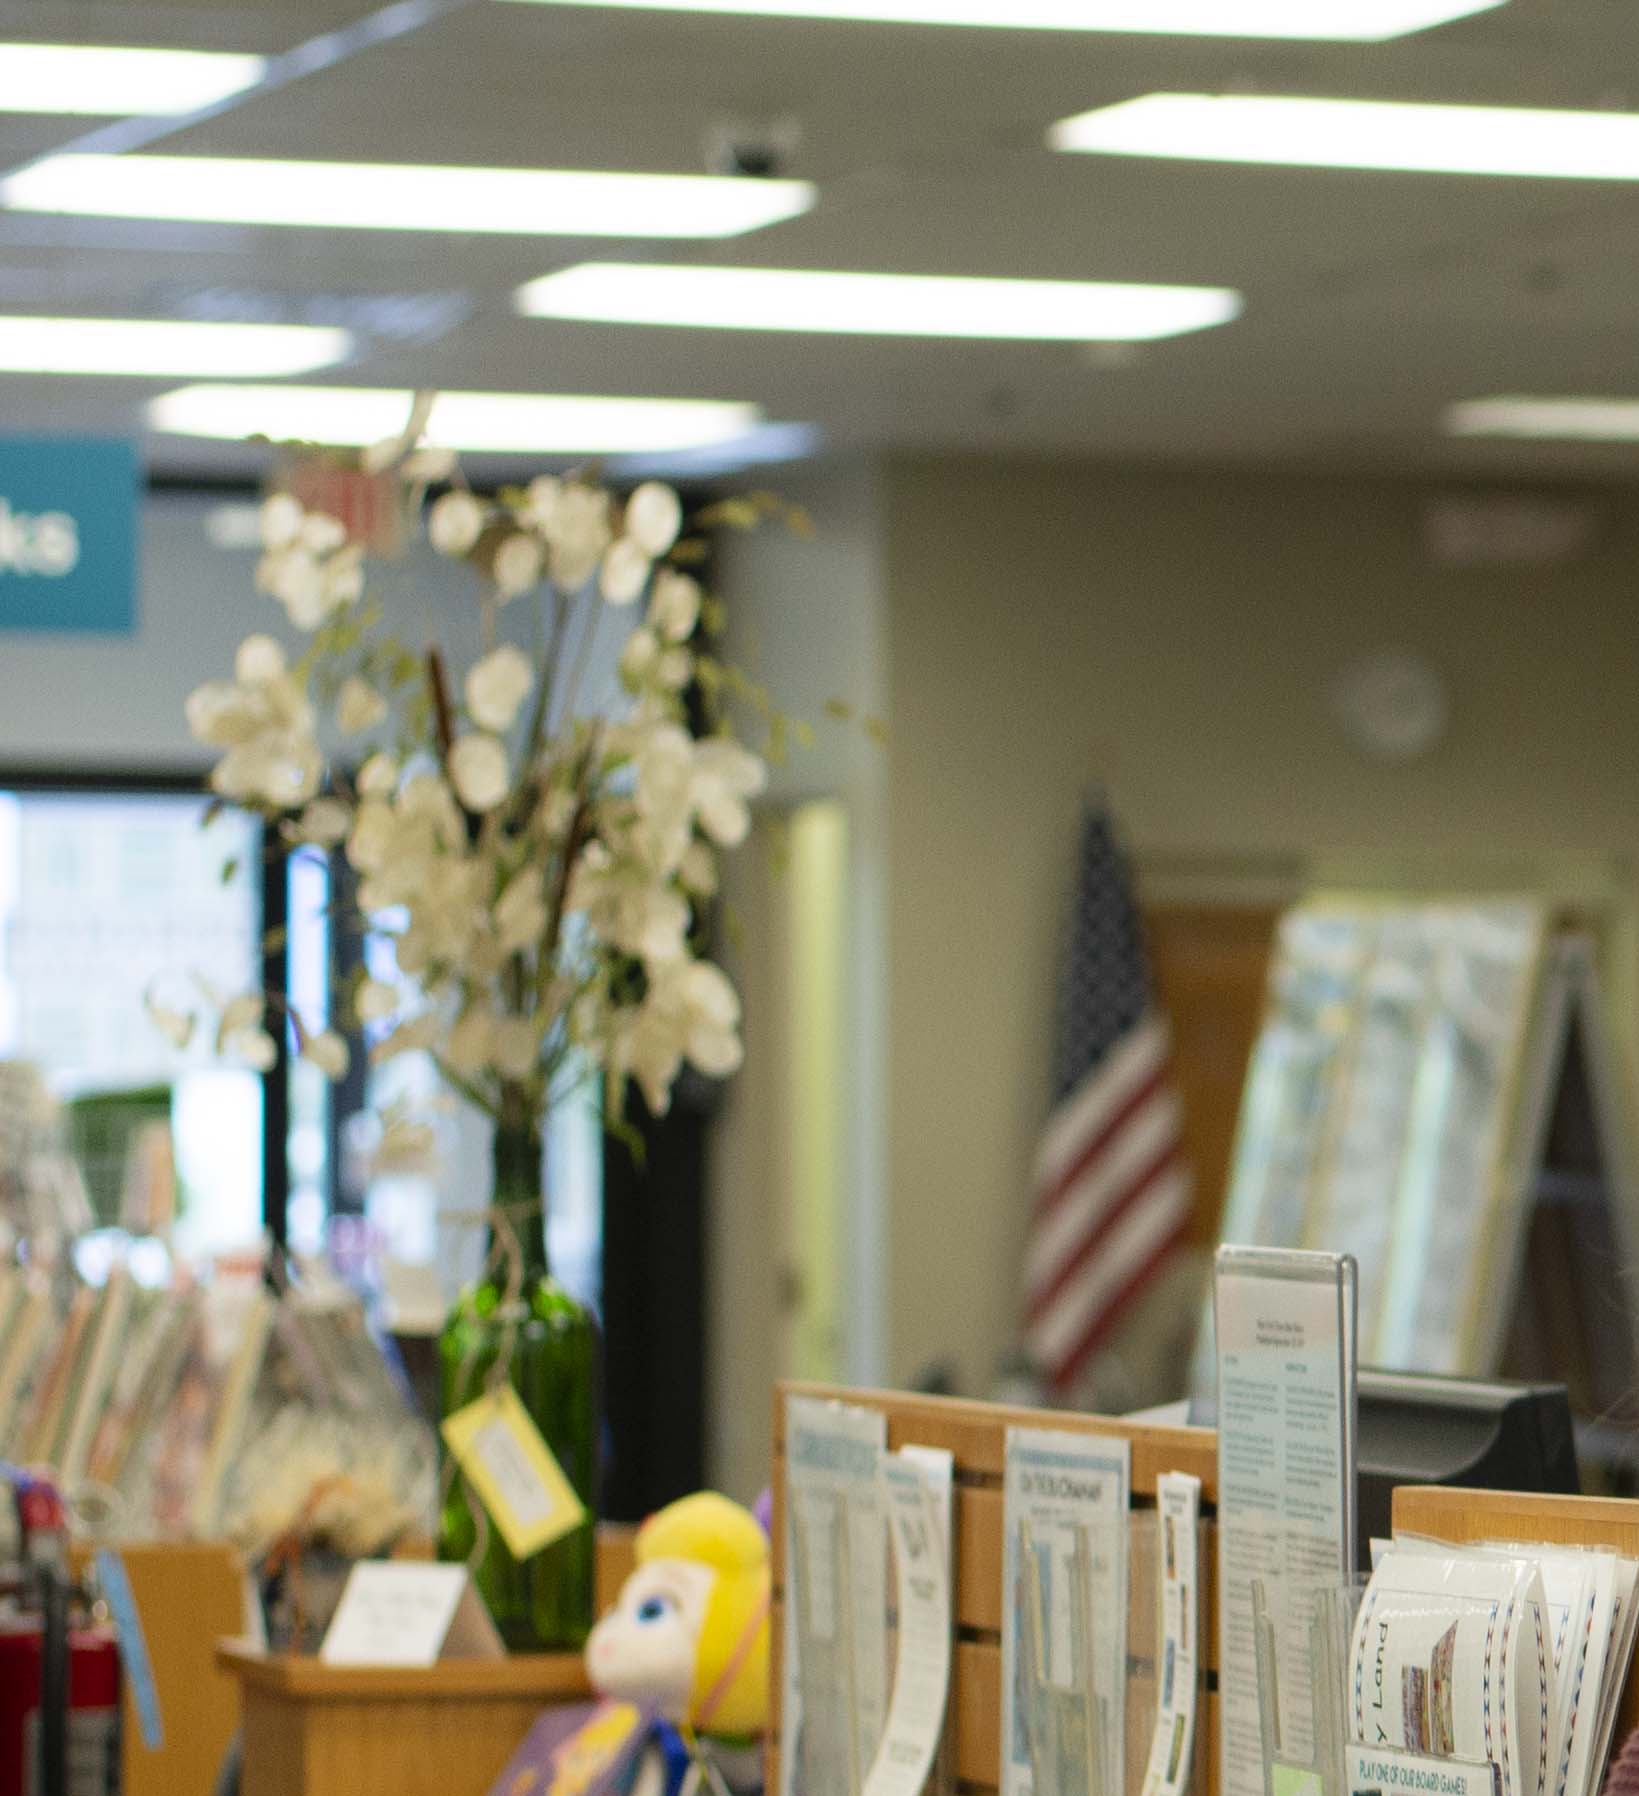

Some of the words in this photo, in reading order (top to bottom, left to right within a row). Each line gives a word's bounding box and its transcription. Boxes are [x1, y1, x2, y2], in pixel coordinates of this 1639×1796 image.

[1373, 1622, 1388, 1709] Land
[1359, 1760, 1376, 1782] PLAY
[1376, 1763, 1389, 1785] ONE
[1390, 1766, 1399, 1785] OF
[1399, 1768, 1414, 1788] OUR
[1414, 1770, 1440, 1793] BOARD
[1439, 1775, 1468, 1796] GAMES!
